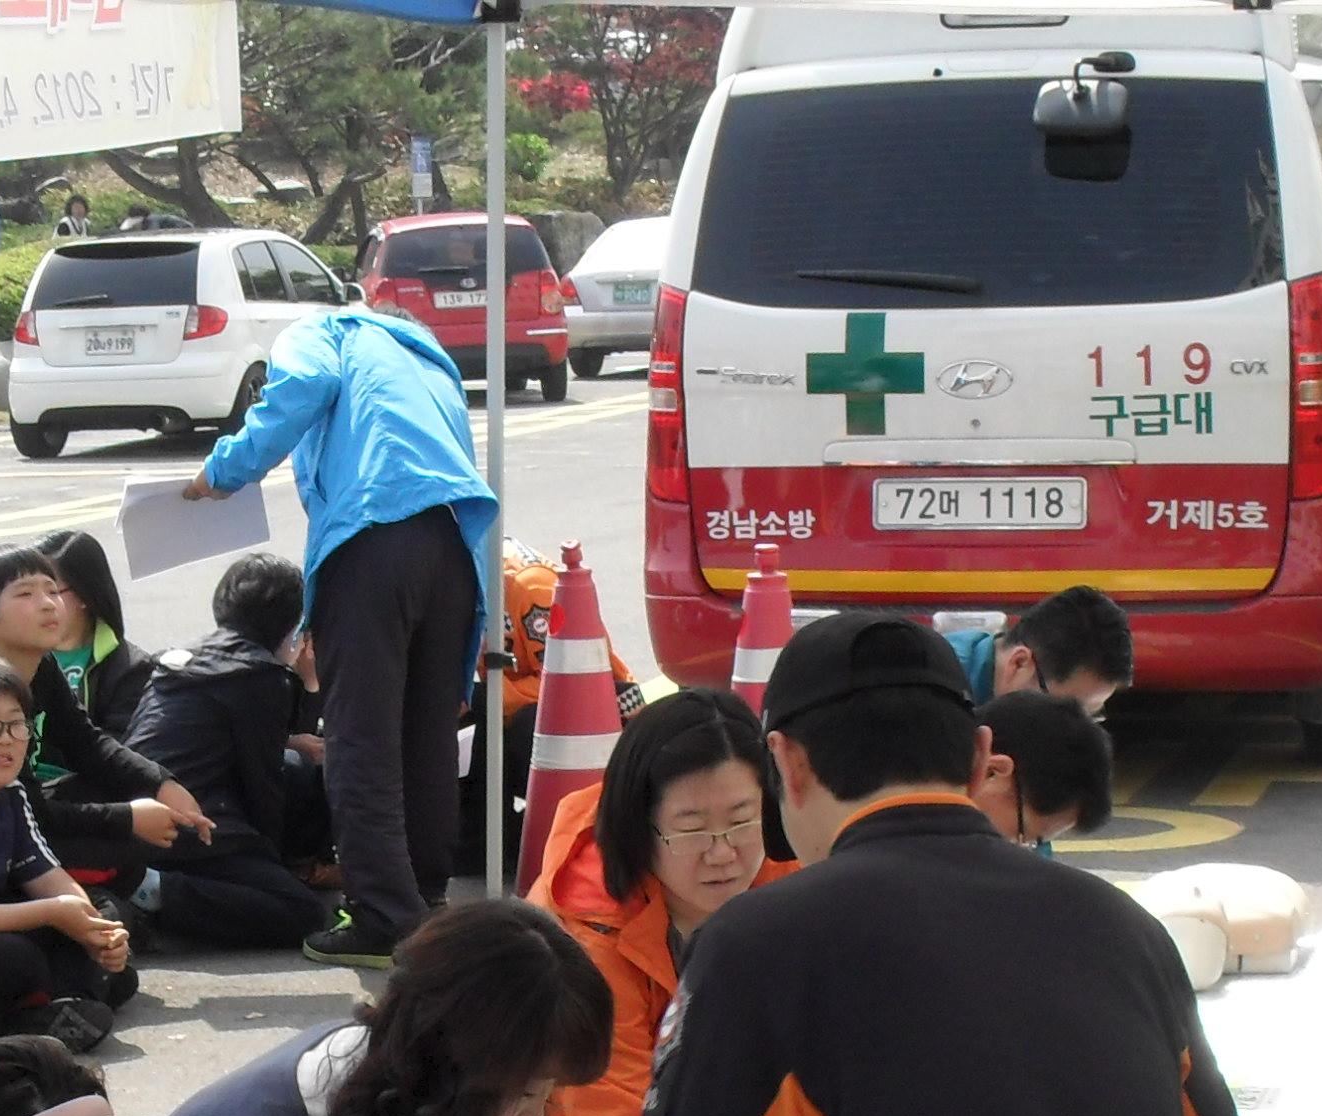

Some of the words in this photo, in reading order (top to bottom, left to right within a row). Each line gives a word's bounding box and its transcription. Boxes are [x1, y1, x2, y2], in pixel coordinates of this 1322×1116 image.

[1089, 391, 1213, 437] 구급대
[895, 487, 960, 521] 72머
[979, 487, 1065, 520] 1118
[1145, 499, 1270, 531] 거제5호
[705, 508, 817, 541] 경남소방
